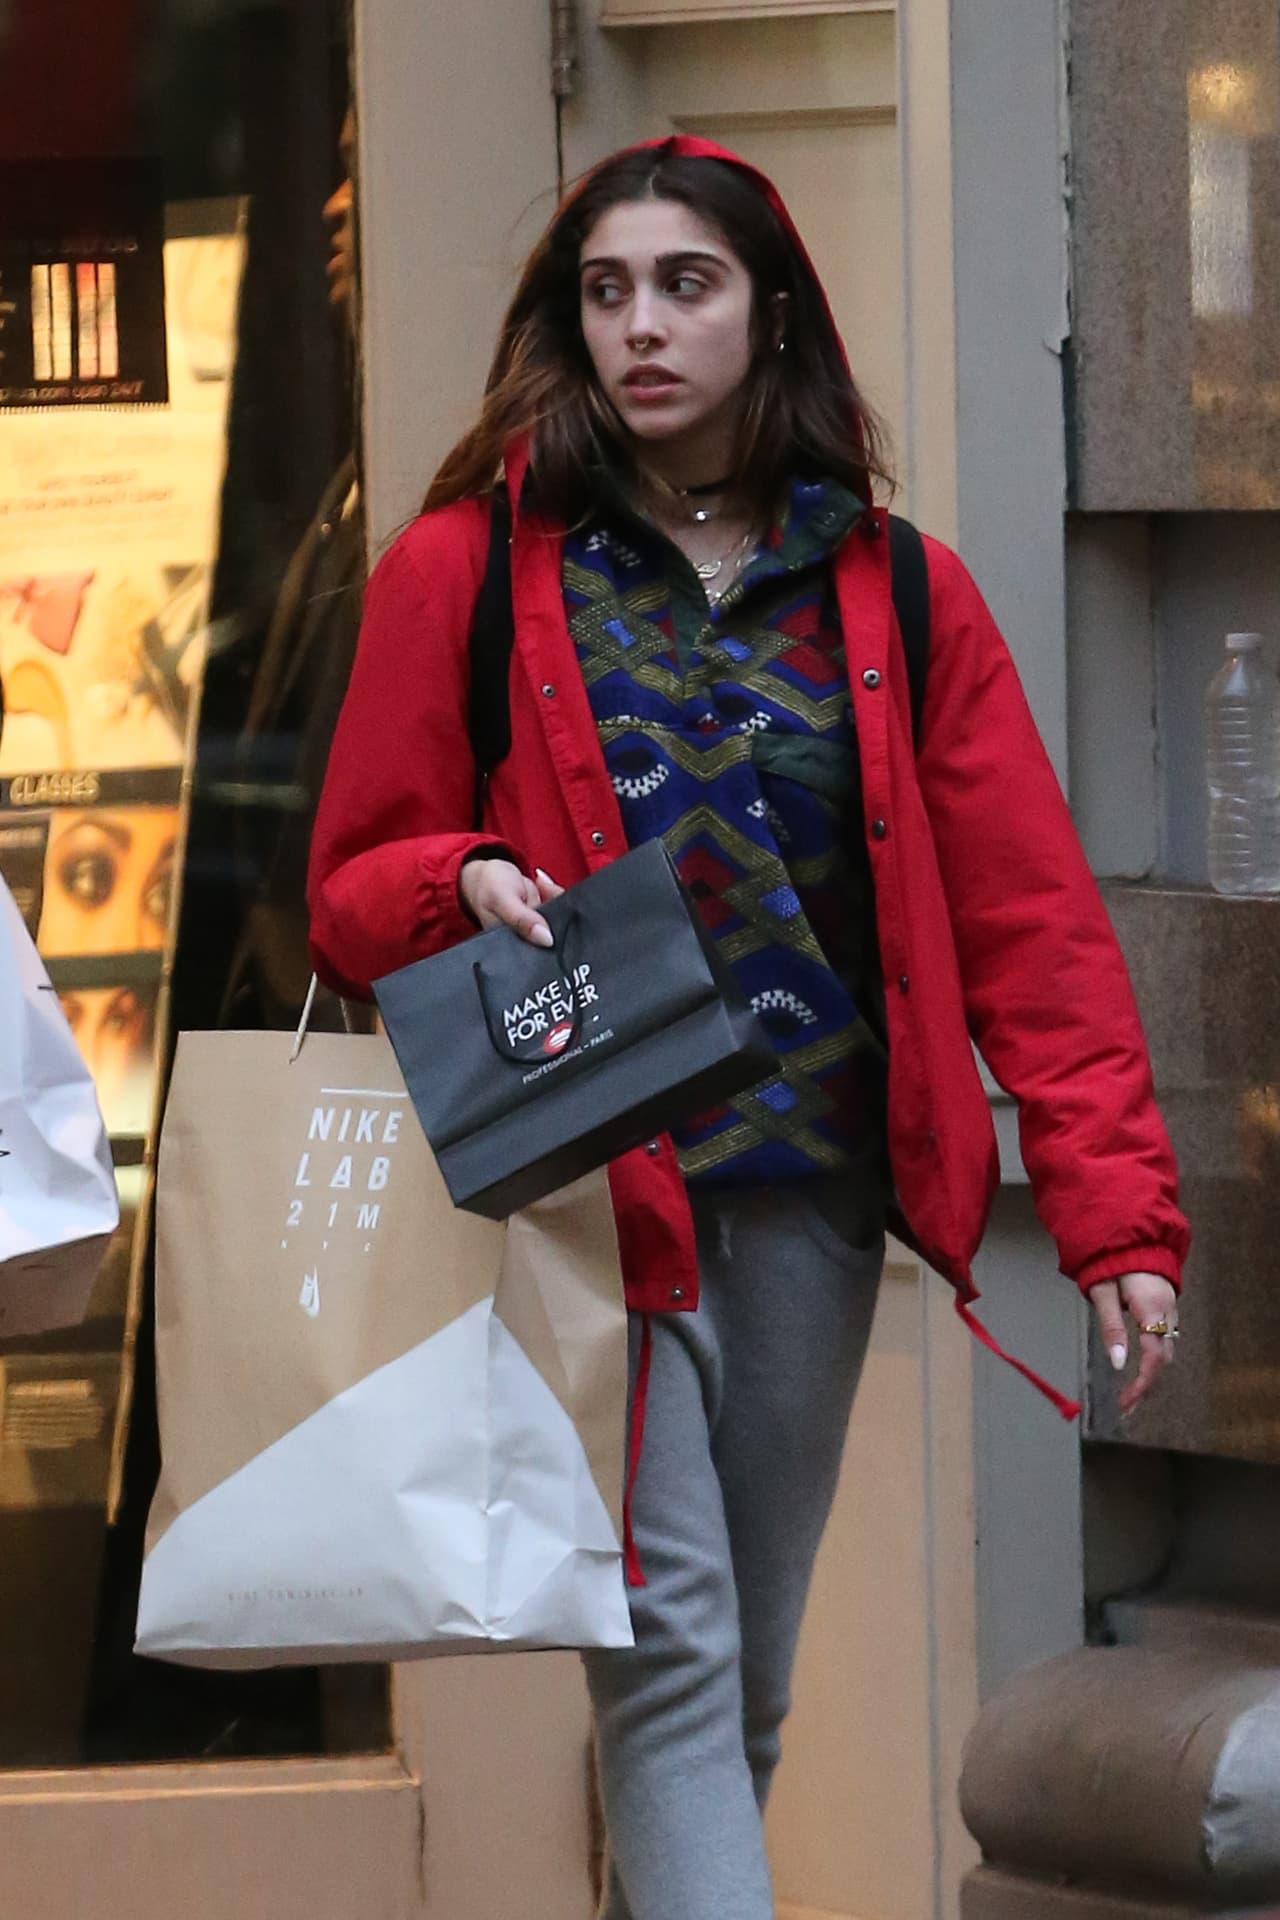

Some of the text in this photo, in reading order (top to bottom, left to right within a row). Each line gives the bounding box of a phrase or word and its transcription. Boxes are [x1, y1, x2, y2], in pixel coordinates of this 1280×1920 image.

[503, 980, 562, 1028] MAKE
[507, 984, 599, 1048] FOR EVER
[522, 1028, 614, 1085] PROFESSIONAL PARIS
[307, 1107, 402, 1144] NIKE
